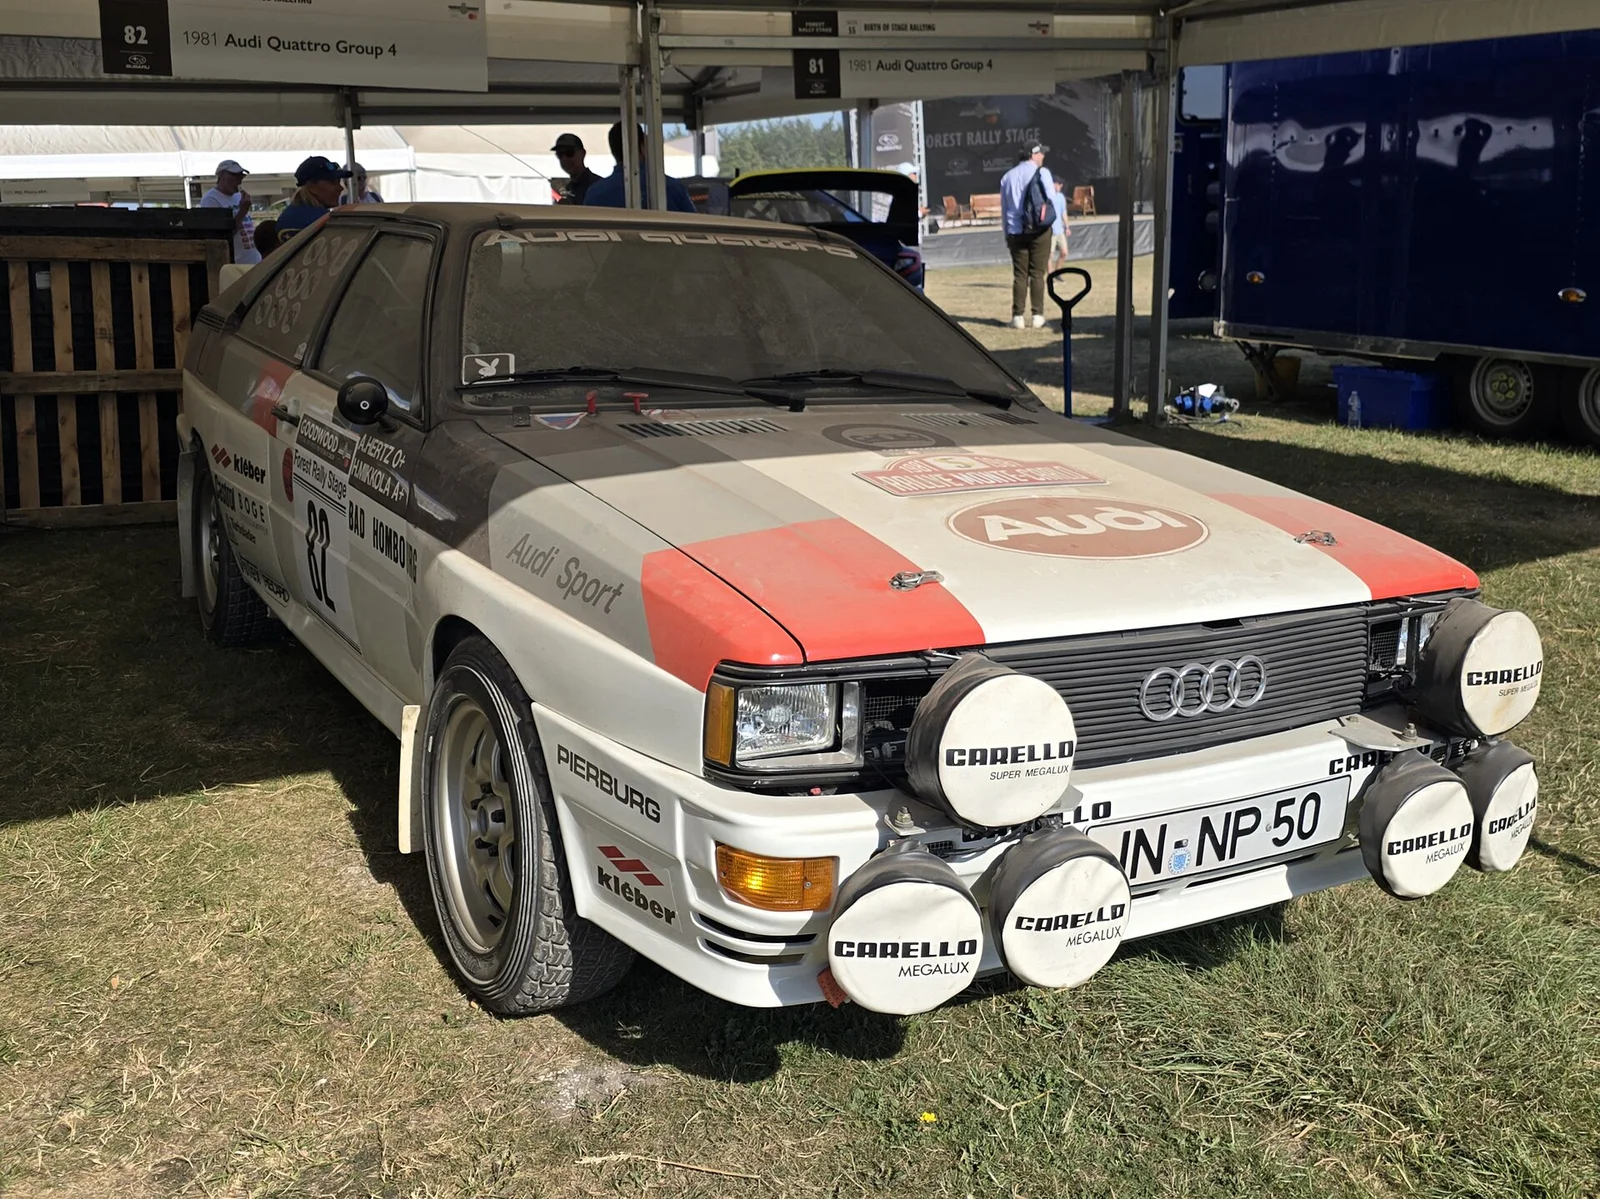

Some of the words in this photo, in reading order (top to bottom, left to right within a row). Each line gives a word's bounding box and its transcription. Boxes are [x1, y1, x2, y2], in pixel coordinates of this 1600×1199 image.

[124, 25, 148, 44] 82
[864, 23, 881, 31] BIRTH
[882, 23, 890, 31] OF
[891, 23, 908, 31] STAGE
[909, 24, 936, 32] RALLYING
[183, 31, 217, 46] 1981
[224, 33, 262, 49] Audi
[267, 36, 330, 53] Quattro
[336, 40, 383, 59] Group
[388, 43, 397, 56] 4
[808, 58, 824, 74] 81
[848, 60, 872, 71] 1981
[876, 59, 901, 71] Audi
[904, 60, 948, 72] Quattro
[951, 59, 984, 73] Group
[987, 59, 993, 70] 4
[966, 129, 1002, 146] RALLY
[1005, 128, 1041, 143] STAGE
[300, 418, 339, 453] GOODWOOD
[360, 433, 395, 465] A.HERTZ
[294, 449, 312, 475] Forest
[312, 460, 327, 489] Rally
[328, 470, 347, 500] Stage
[350, 458, 392, 496] H.MIKKOLA
[391, 481, 405, 501] A+
[348, 500, 365, 539] BAD
[976, 506, 1188, 542] Audi
[305, 500, 336, 613] 82
[506, 533, 560, 580] Audi
[556, 556, 624, 614] Sport
[1466, 660, 1543, 686] CARELLO
[1498, 687, 1519, 696] SUPER
[945, 740, 1074, 766] CARELLO
[557, 743, 662, 824] PIERBURG
[989, 769, 1021, 781] SUPER
[1025, 765, 1069, 778] MEGALUX
[1272, 791, 1321, 847] 50
[1387, 823, 1472, 856] CARELLO
[1425, 841, 1467, 865] MEGALUX
[597, 865, 676, 927] kléber
[1015, 903, 1126, 932] CARELLO
[834, 939, 978, 959] CARELLO
[1065, 925, 1122, 948] MEGALUX
[898, 962, 970, 978] MEGALUX
